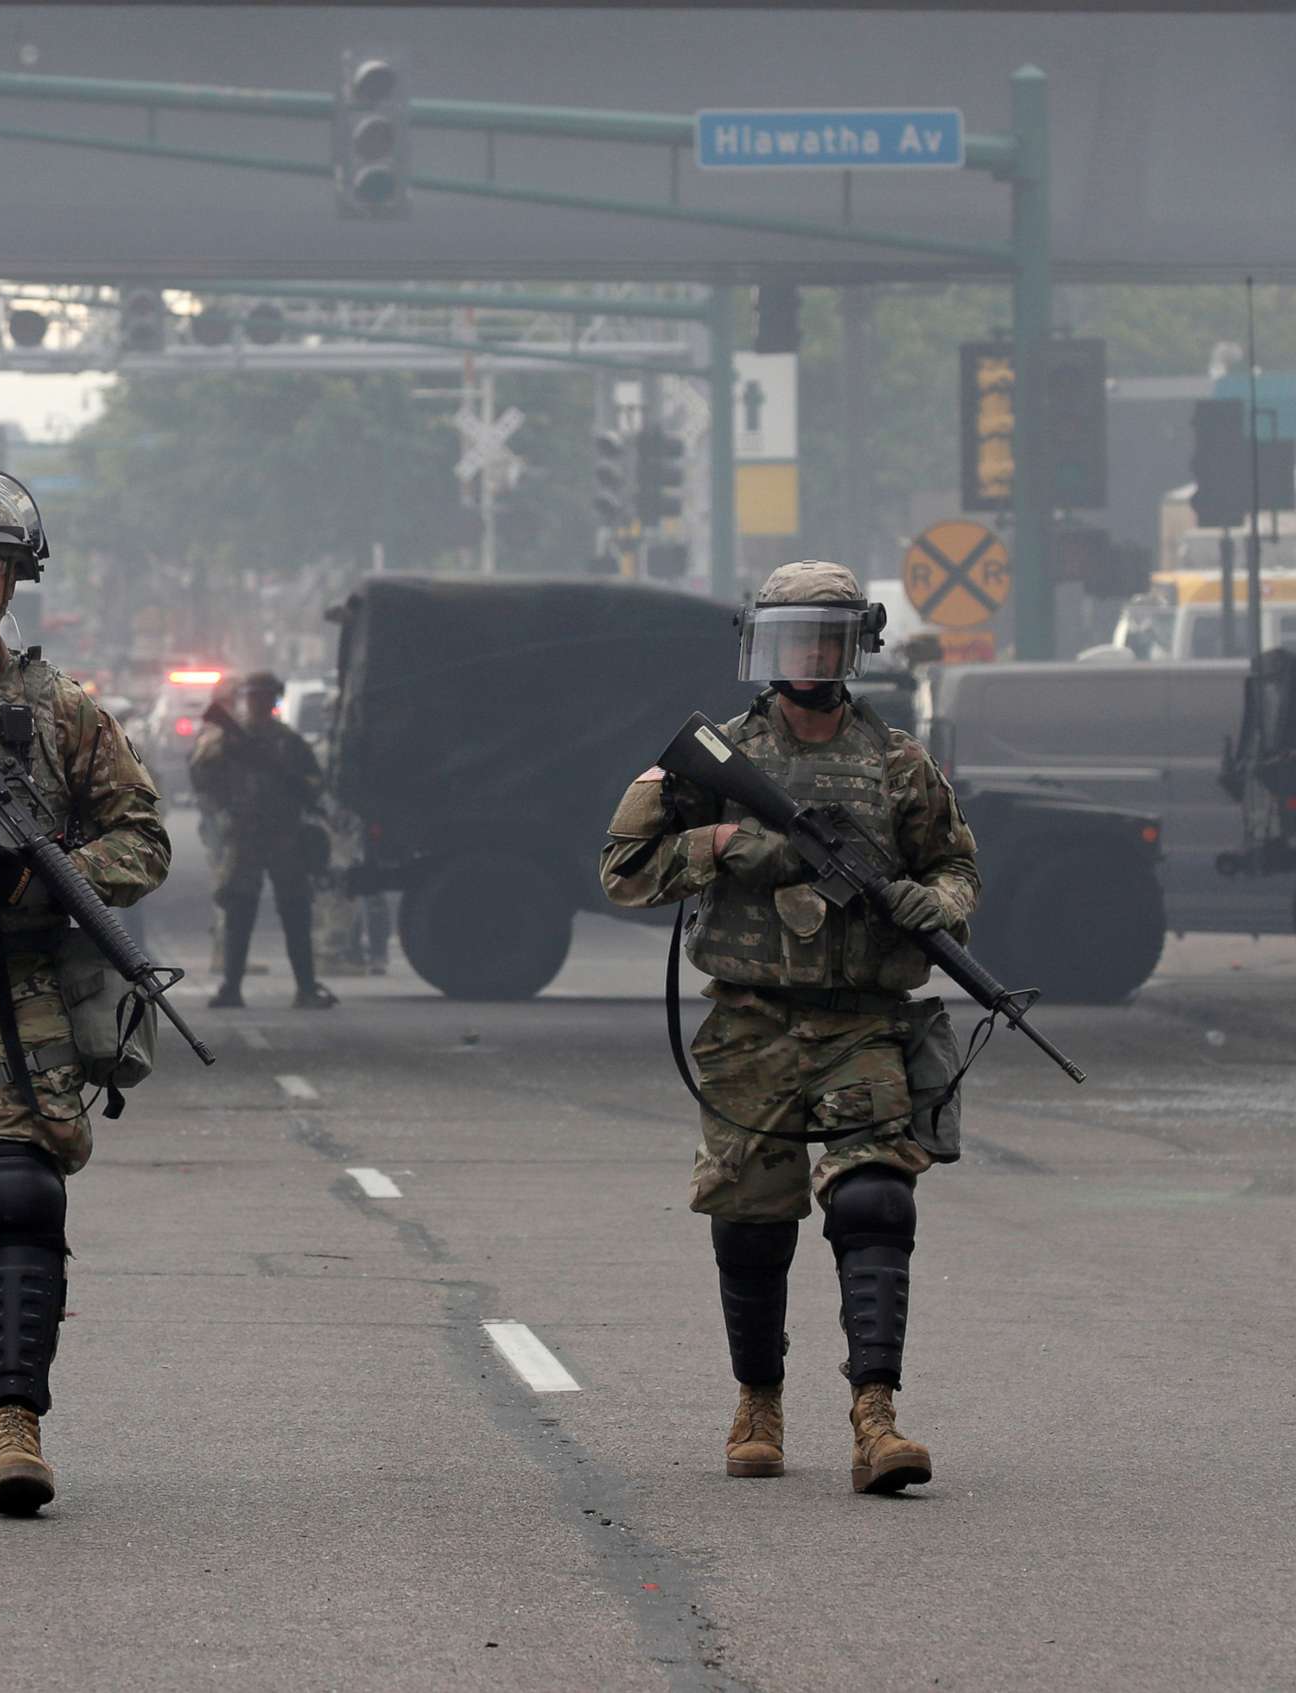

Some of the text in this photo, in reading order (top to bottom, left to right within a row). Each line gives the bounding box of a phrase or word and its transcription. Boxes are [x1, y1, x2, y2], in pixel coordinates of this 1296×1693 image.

[898, 123, 943, 154] Av
[911, 560, 1004, 587] R R
